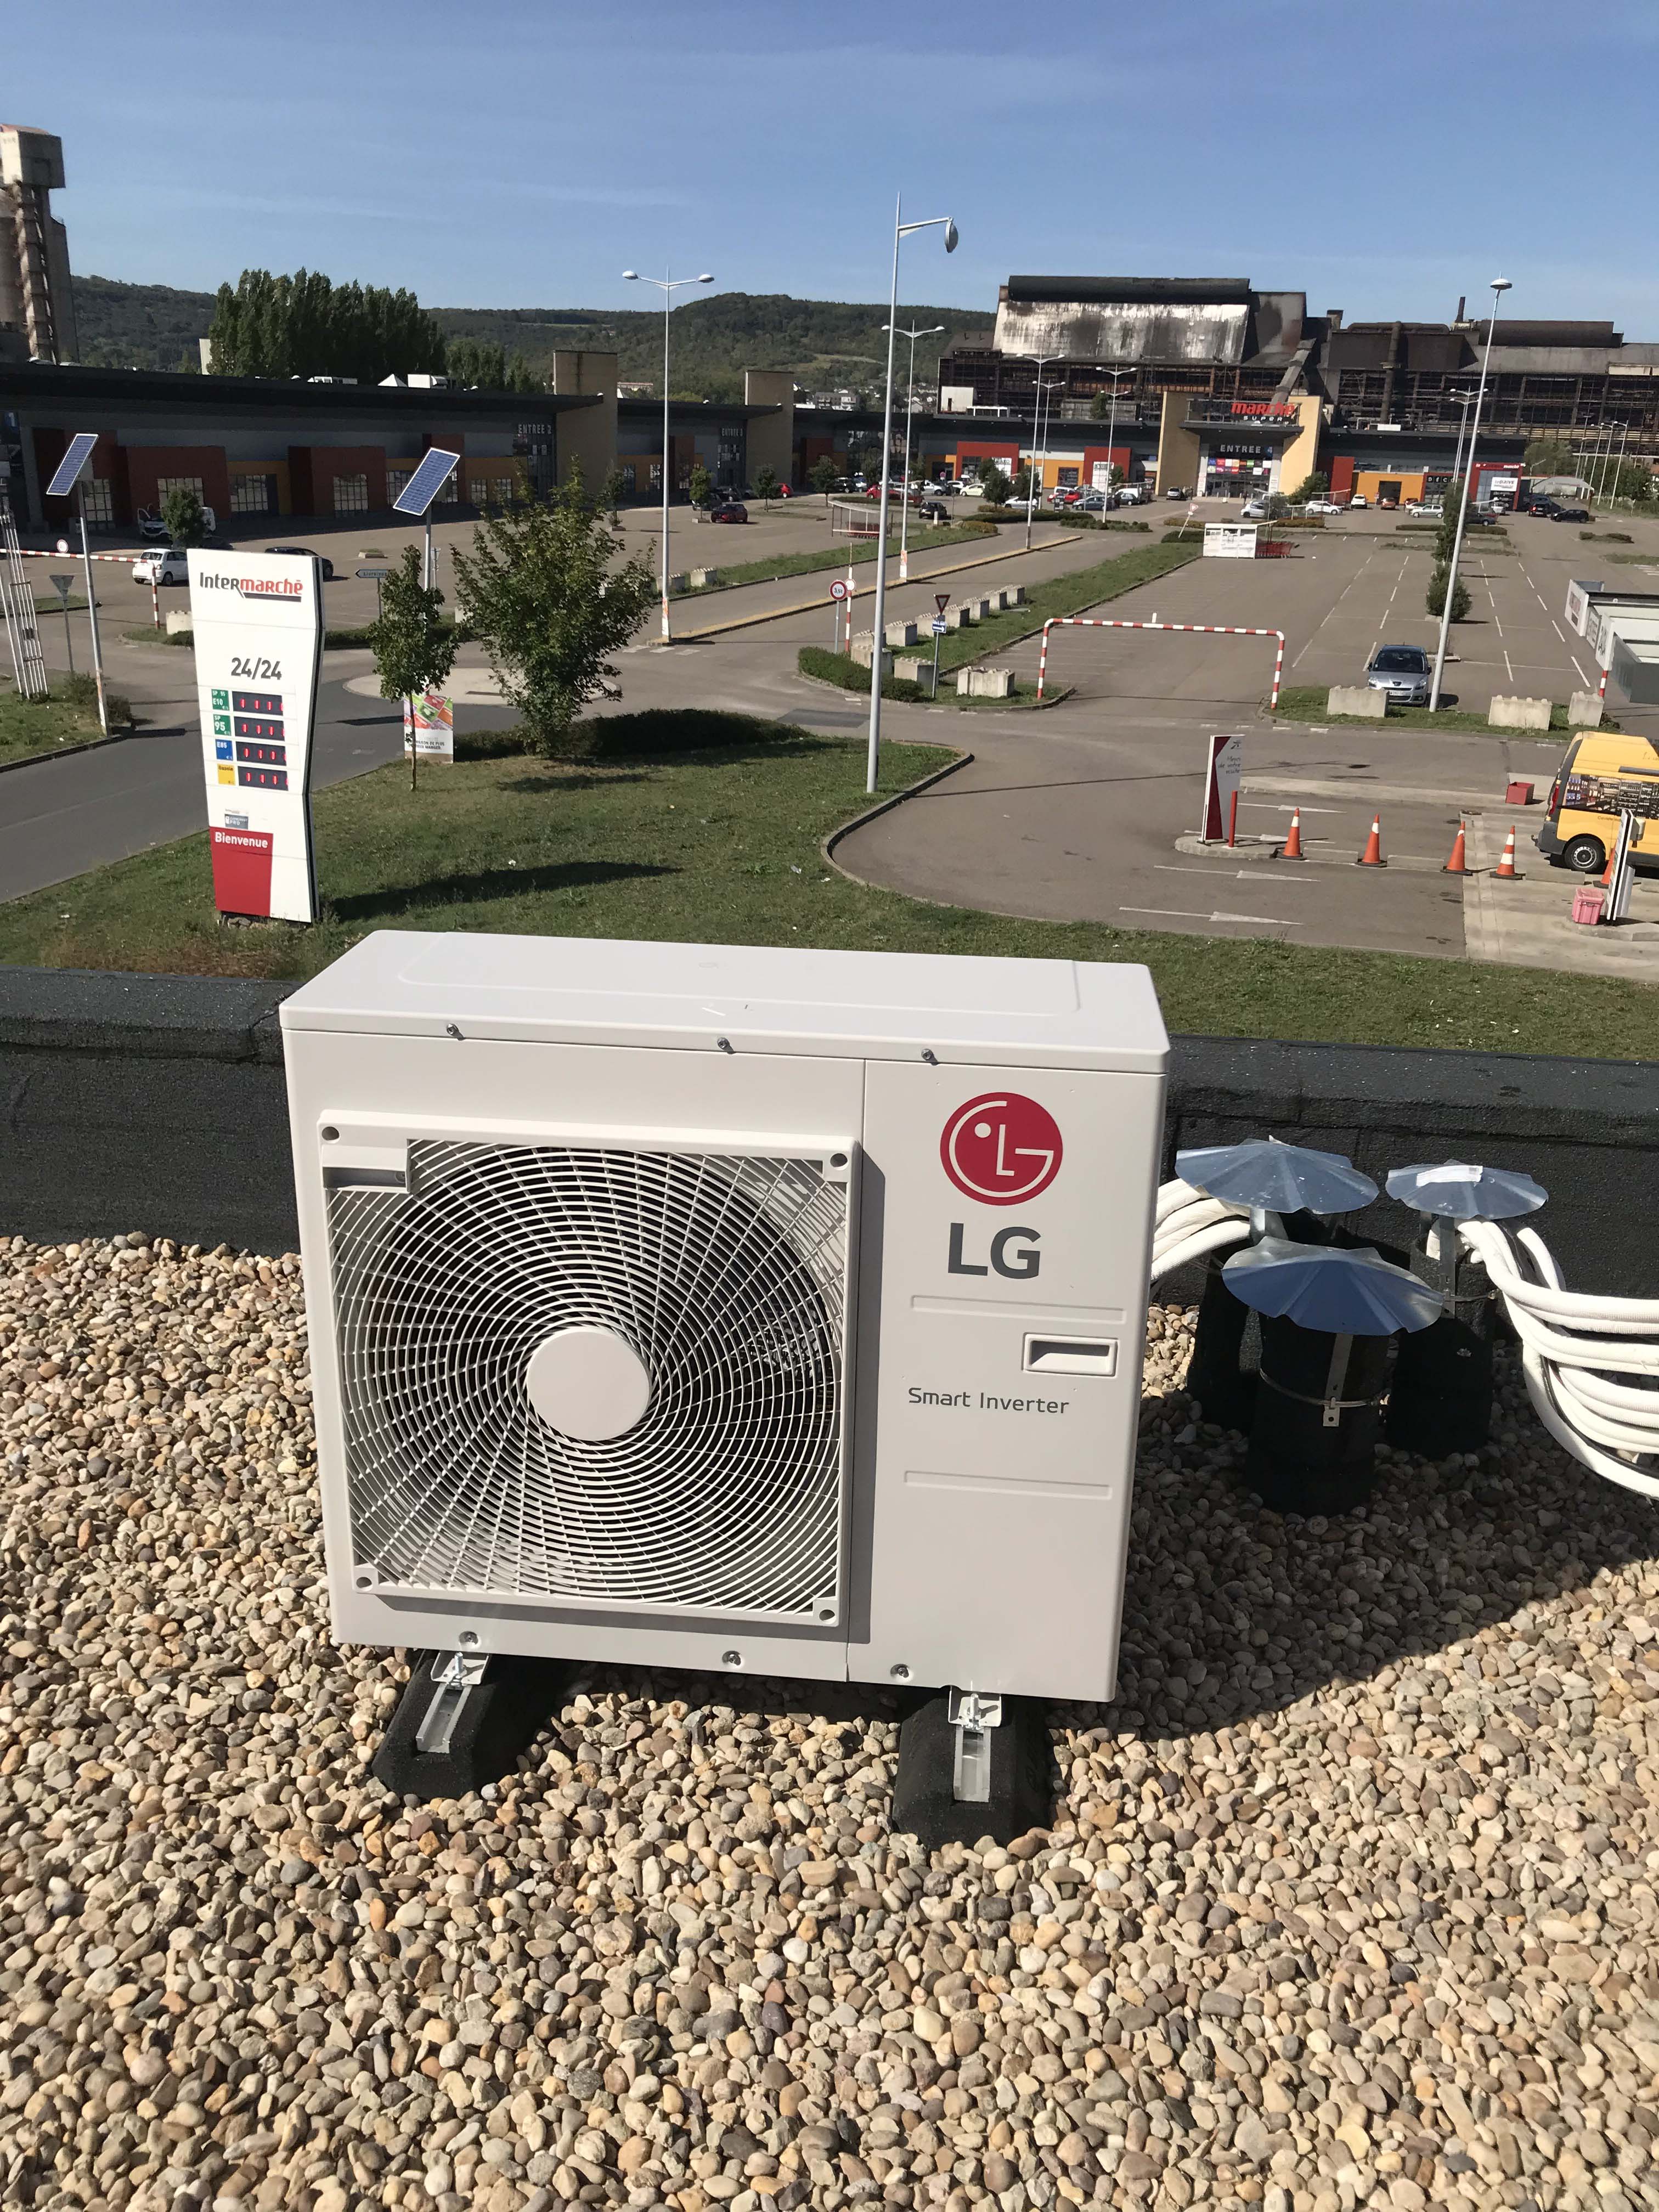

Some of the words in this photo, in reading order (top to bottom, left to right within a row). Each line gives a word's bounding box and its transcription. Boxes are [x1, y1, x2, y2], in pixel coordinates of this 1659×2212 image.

[518, 424, 545, 435] ENTREE
[1220, 445, 1261, 453] ENTREE
[231, 657, 282, 680] 24/24
[215, 721, 225, 731] 95
[215, 832, 268, 848] Bienvenue
[948, 1222, 1041, 1279] LG
[909, 1387, 971, 1407] Smart
[980, 1392, 1069, 1414] Inverter
